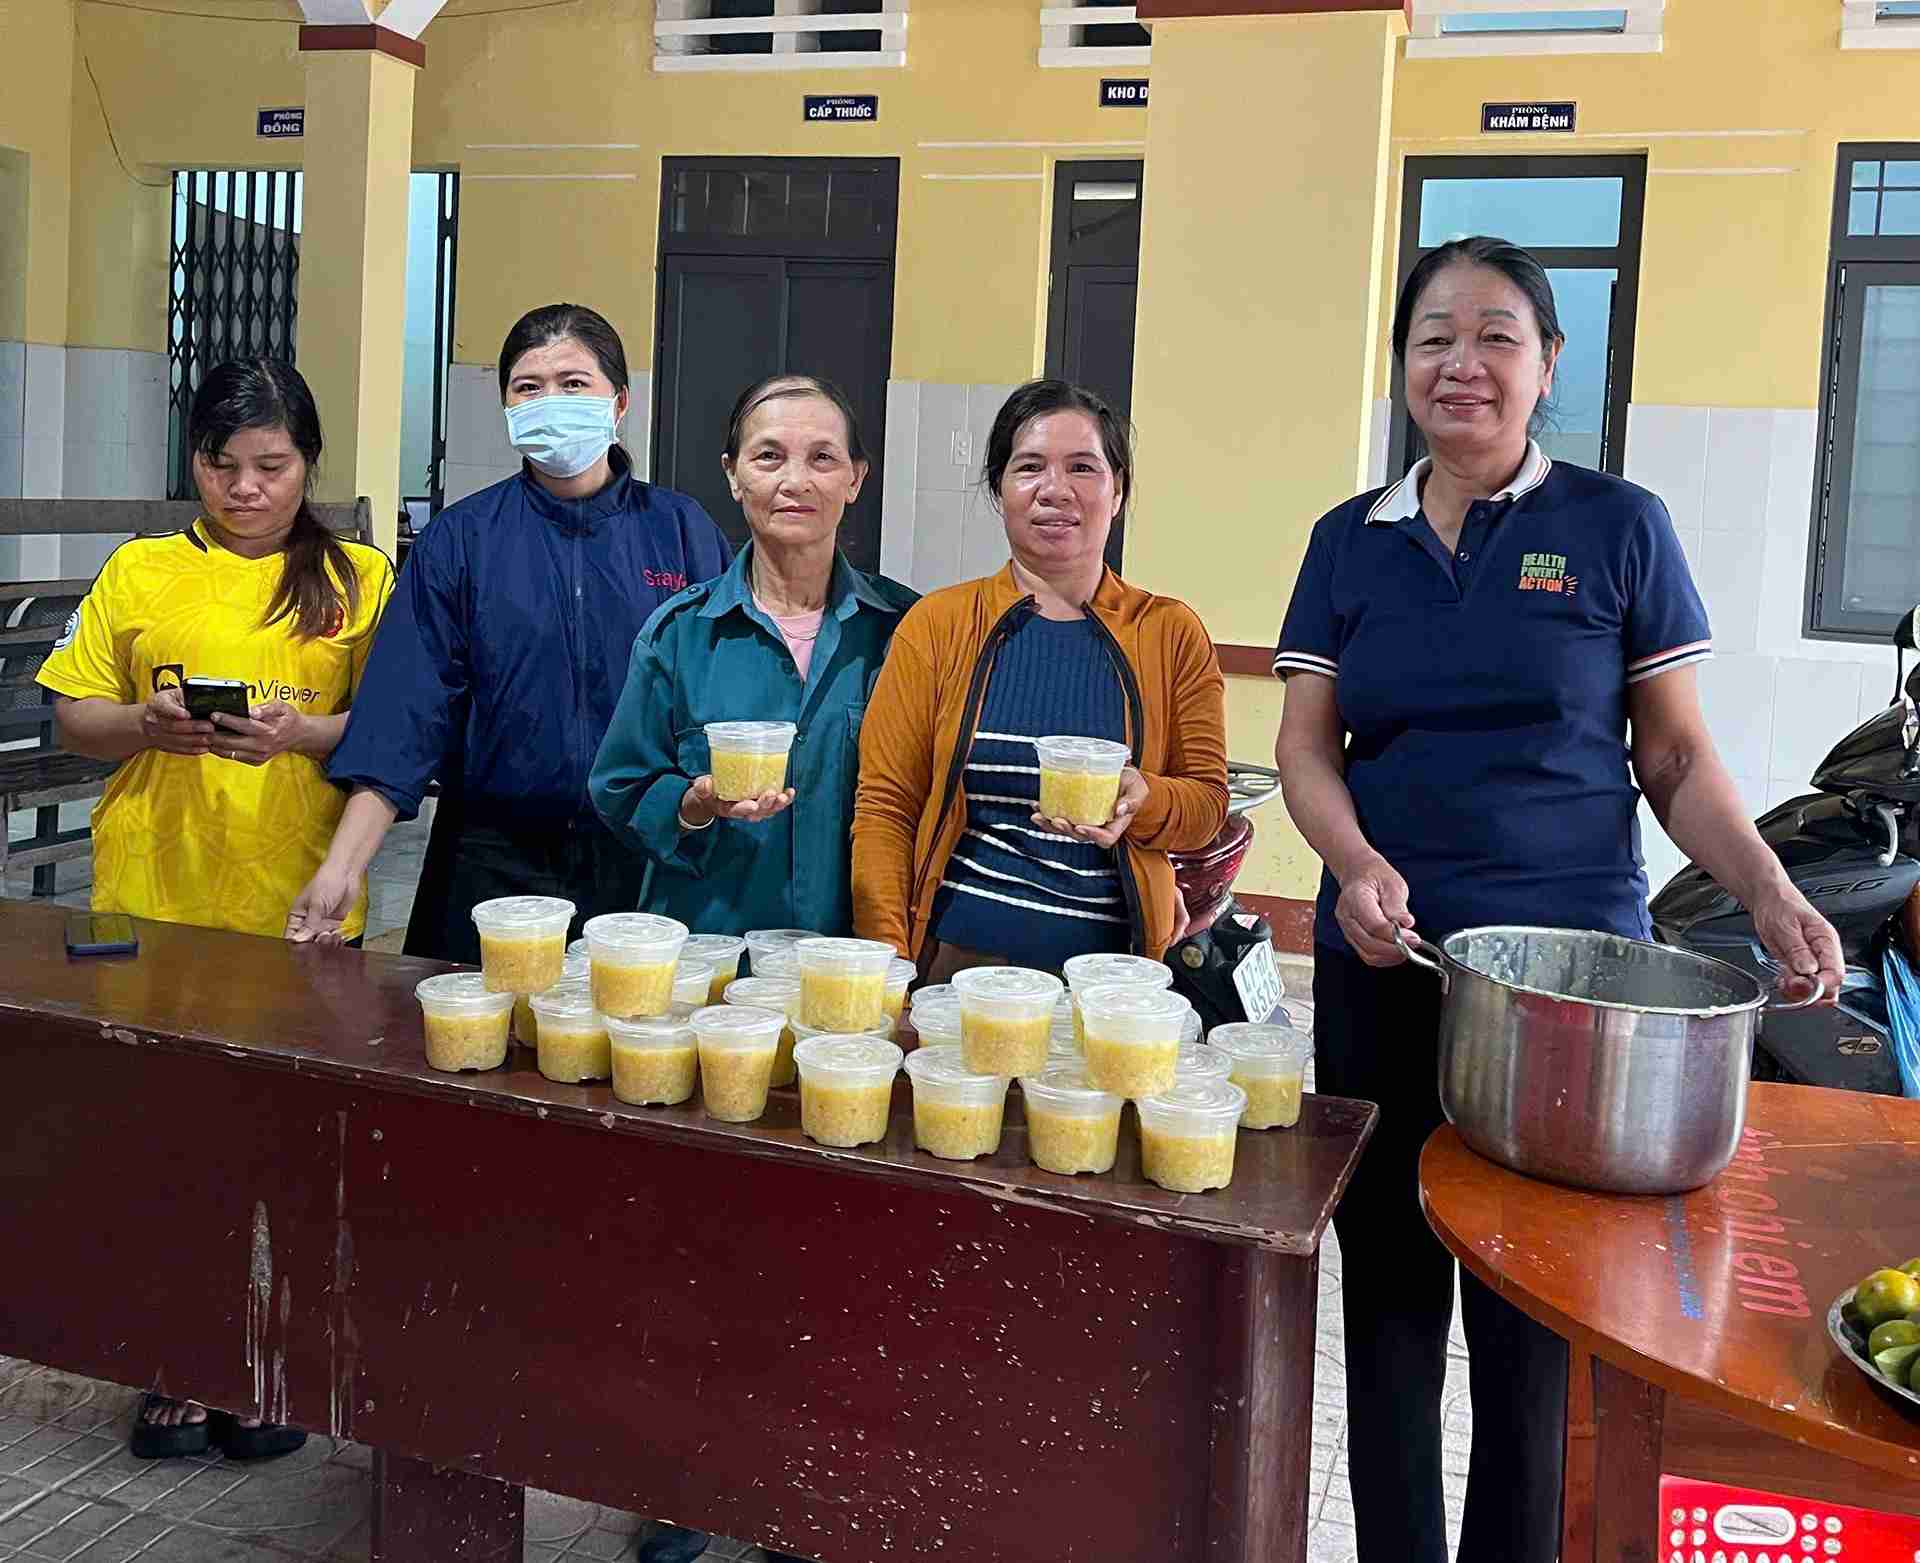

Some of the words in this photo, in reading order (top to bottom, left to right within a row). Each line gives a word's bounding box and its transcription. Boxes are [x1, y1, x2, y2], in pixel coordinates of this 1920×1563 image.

[1108, 86, 1136, 99] KHO
[809, 104, 833, 118] CẤP
[835, 103, 872, 118] THUỐC
[1490, 114, 1529, 128] KHÁM
[1532, 114, 1569, 130] BỆNH
[1522, 553, 1567, 569] HEALTH
[1520, 566, 1565, 579] POVERTY
[1518, 576, 1564, 593] ACTION
